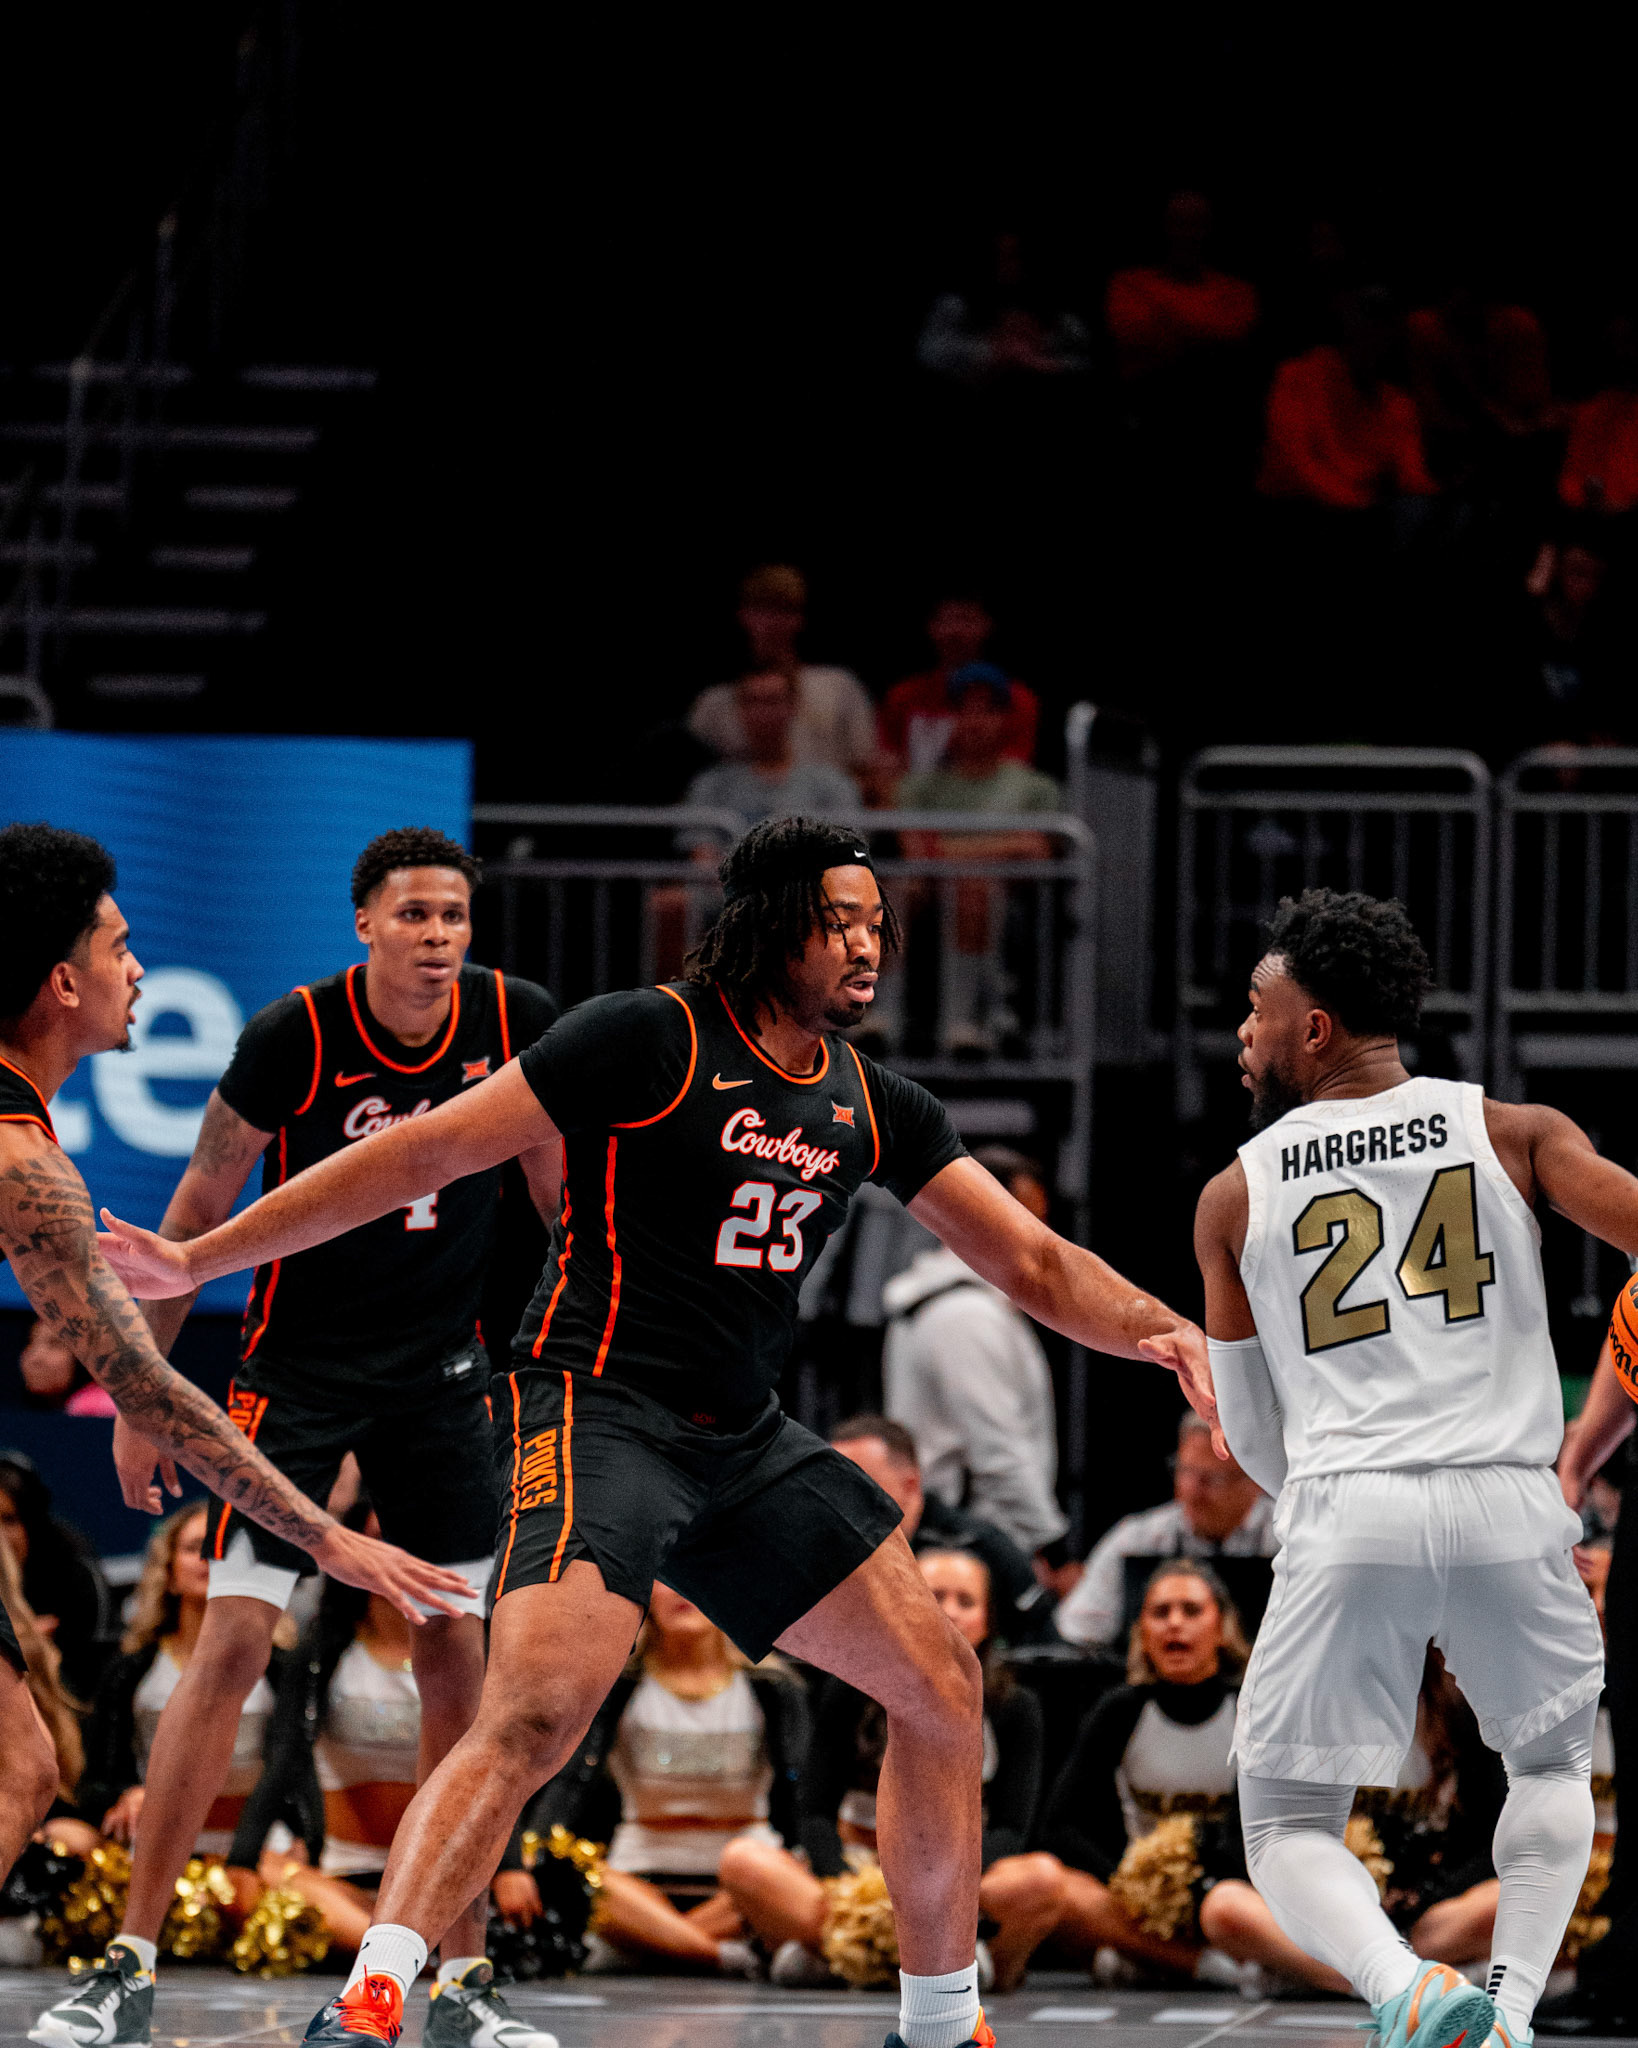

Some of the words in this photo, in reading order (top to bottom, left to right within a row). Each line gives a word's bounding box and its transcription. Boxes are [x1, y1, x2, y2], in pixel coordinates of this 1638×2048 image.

[720, 1107, 840, 1181] Cowboys
[1281, 1113, 1448, 1182] HARGRESS
[714, 1180, 823, 1272] 23
[1292, 1162, 1496, 1356] 24
[520, 1428, 558, 1510] POKES
